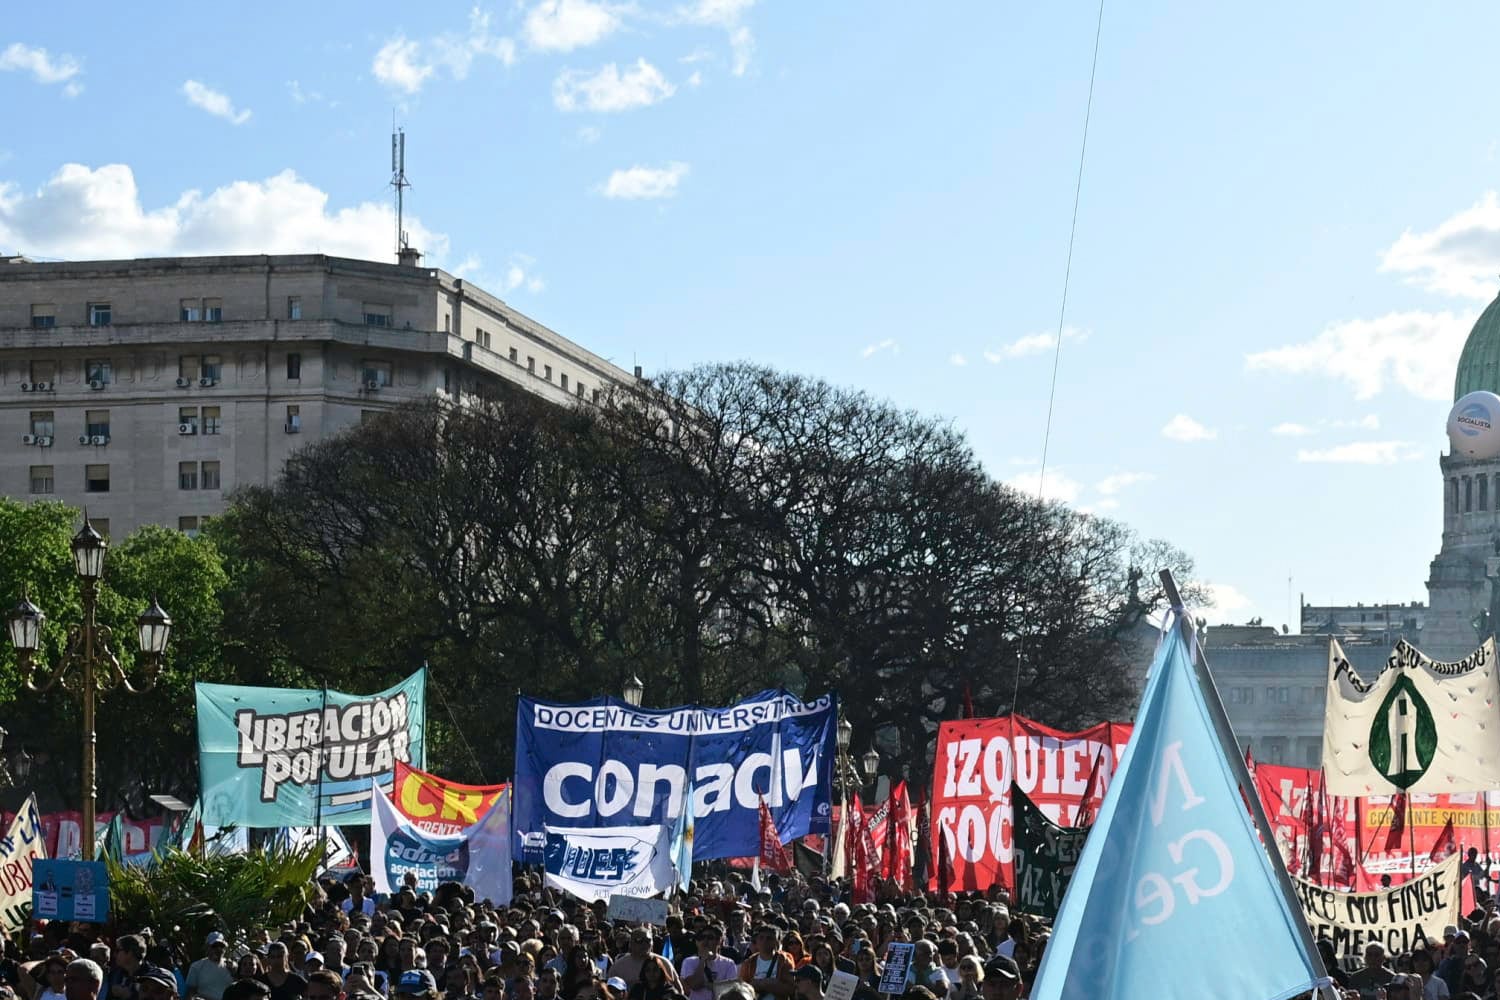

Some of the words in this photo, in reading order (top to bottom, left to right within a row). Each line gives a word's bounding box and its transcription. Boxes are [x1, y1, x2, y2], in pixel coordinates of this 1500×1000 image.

[1457, 416, 1491, 429] SOCIALISTA
[237, 691, 408, 767] LIBERACIÓN
[539, 706, 659, 728] DOCENTES
[669, 695, 830, 732] UNIVERSITARIOS
[261, 732, 410, 801] POPULAR
[543, 732, 818, 818] conadu
[1346, 896, 1378, 925] NO
[1388, 871, 1447, 922] FINGE
